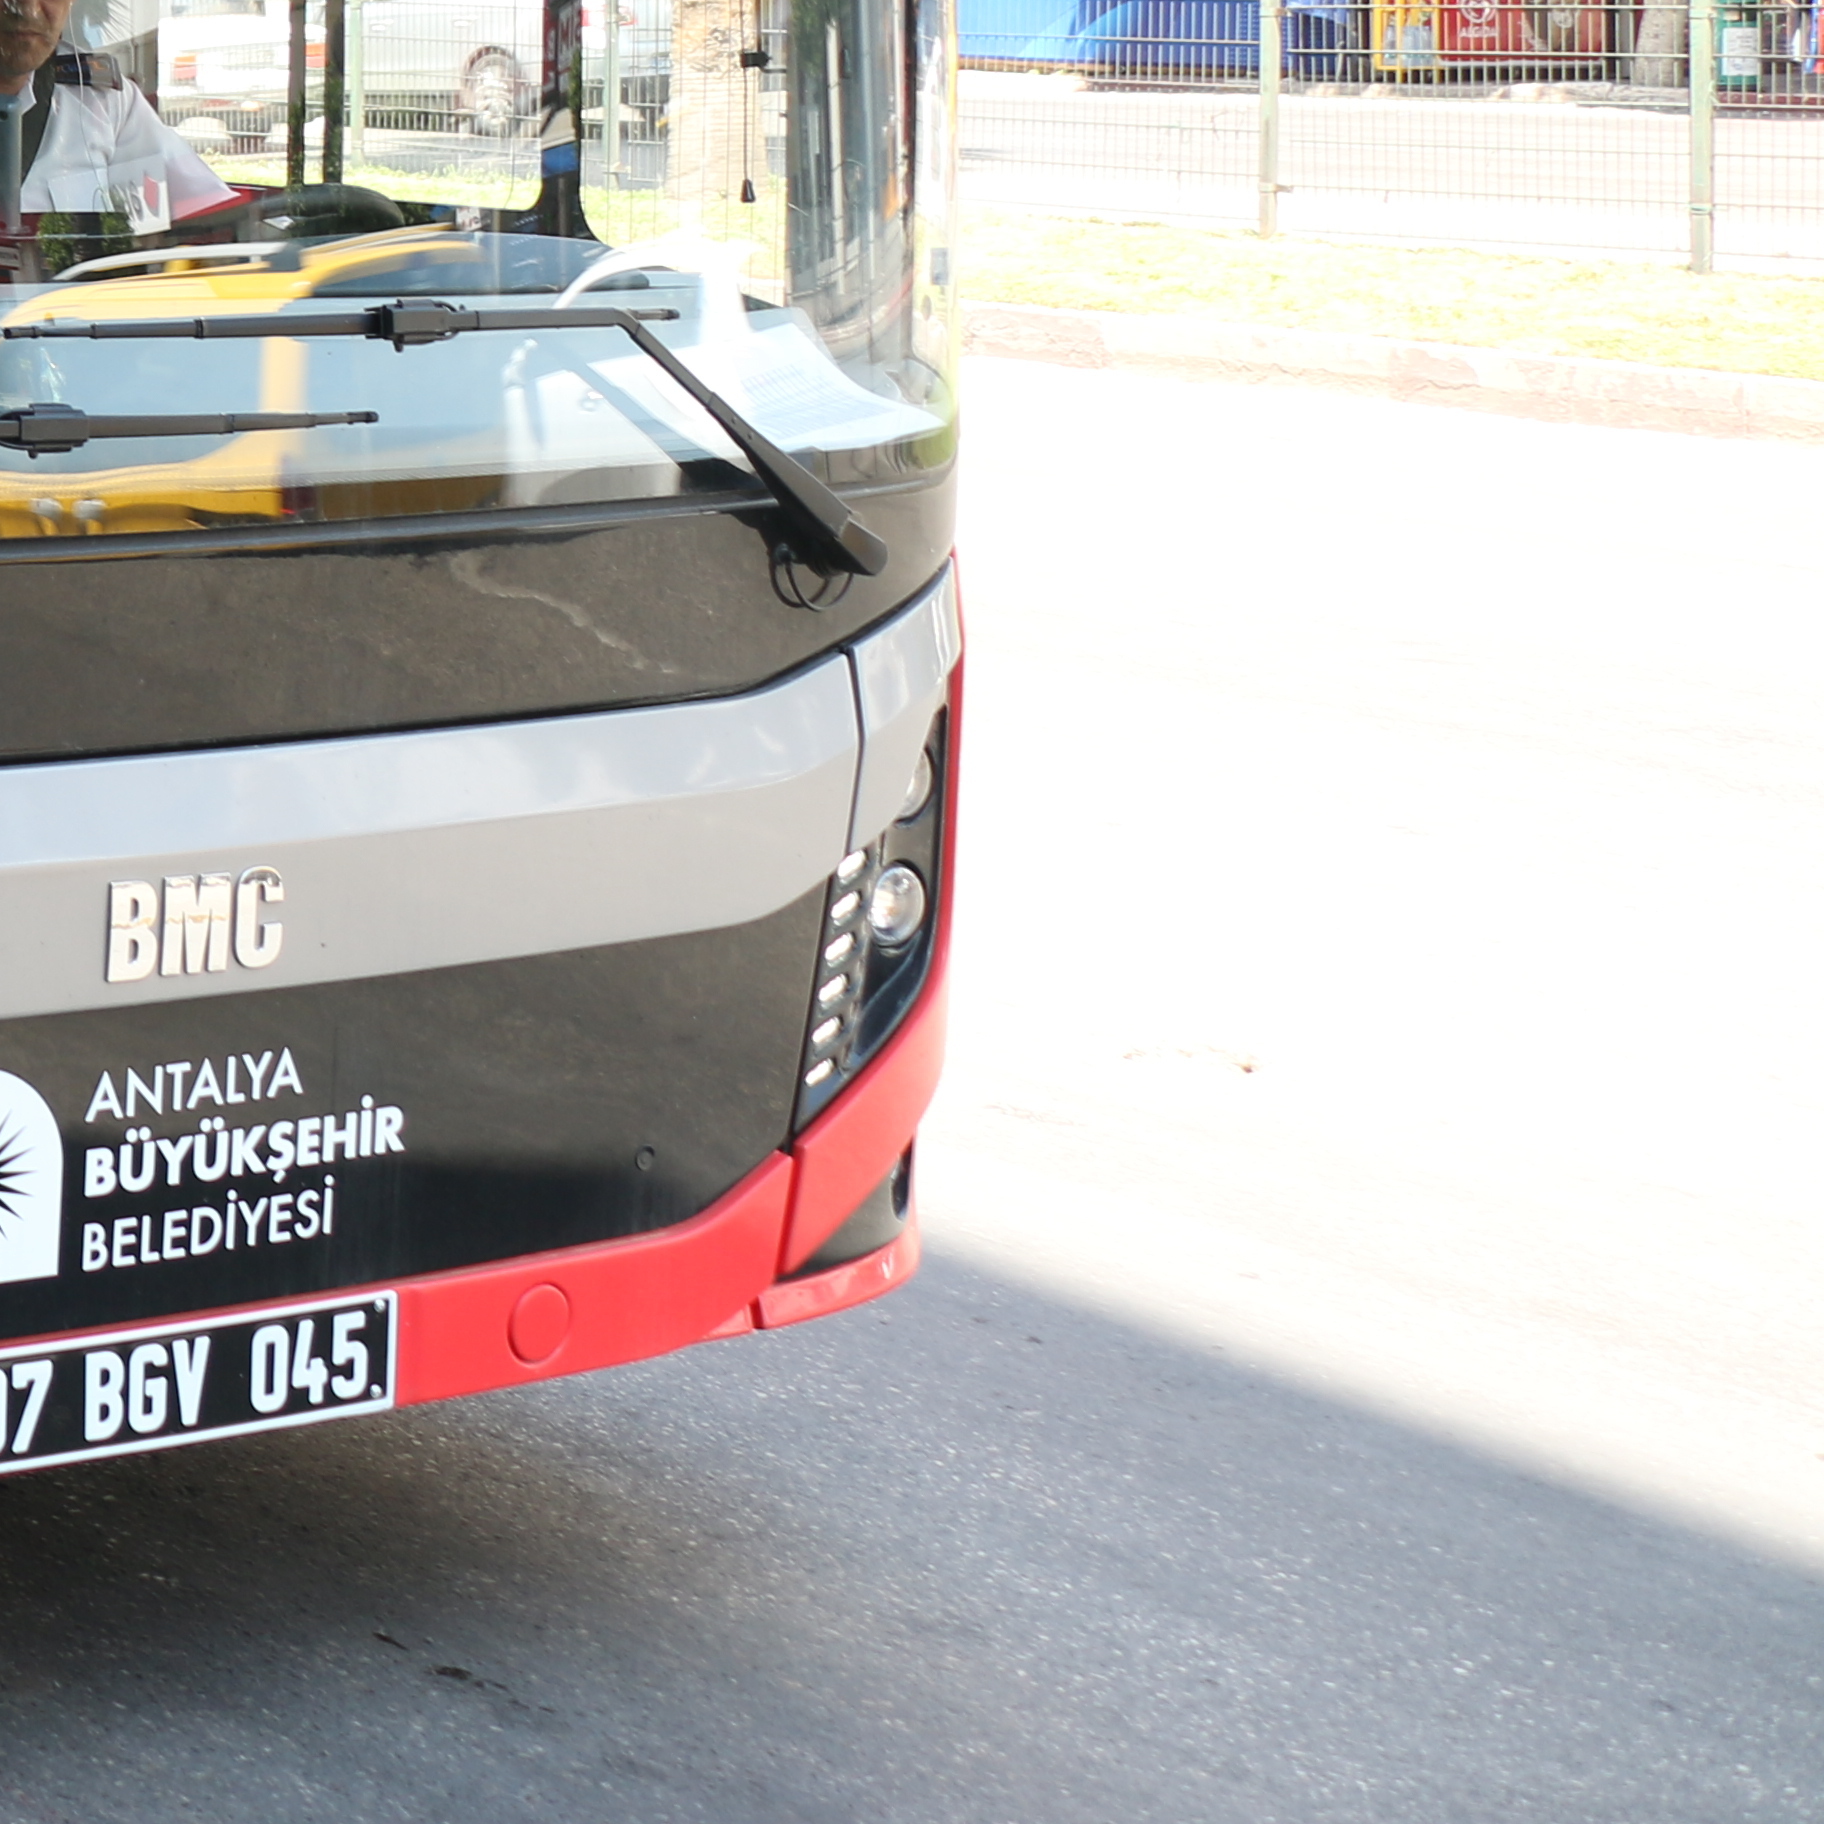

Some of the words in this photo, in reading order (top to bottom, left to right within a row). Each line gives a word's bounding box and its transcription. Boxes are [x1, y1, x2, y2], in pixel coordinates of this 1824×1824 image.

[107, 865, 285, 984] BMC
[84, 1046, 304, 1123] ANTALYA
[83, 1095, 405, 1198] BÜYÜKŞEHİR
[80, 1176, 335, 1272] BELEDİYESİ
[82, 1335, 211, 1442] BGV
[250, 1310, 369, 1415] 045
